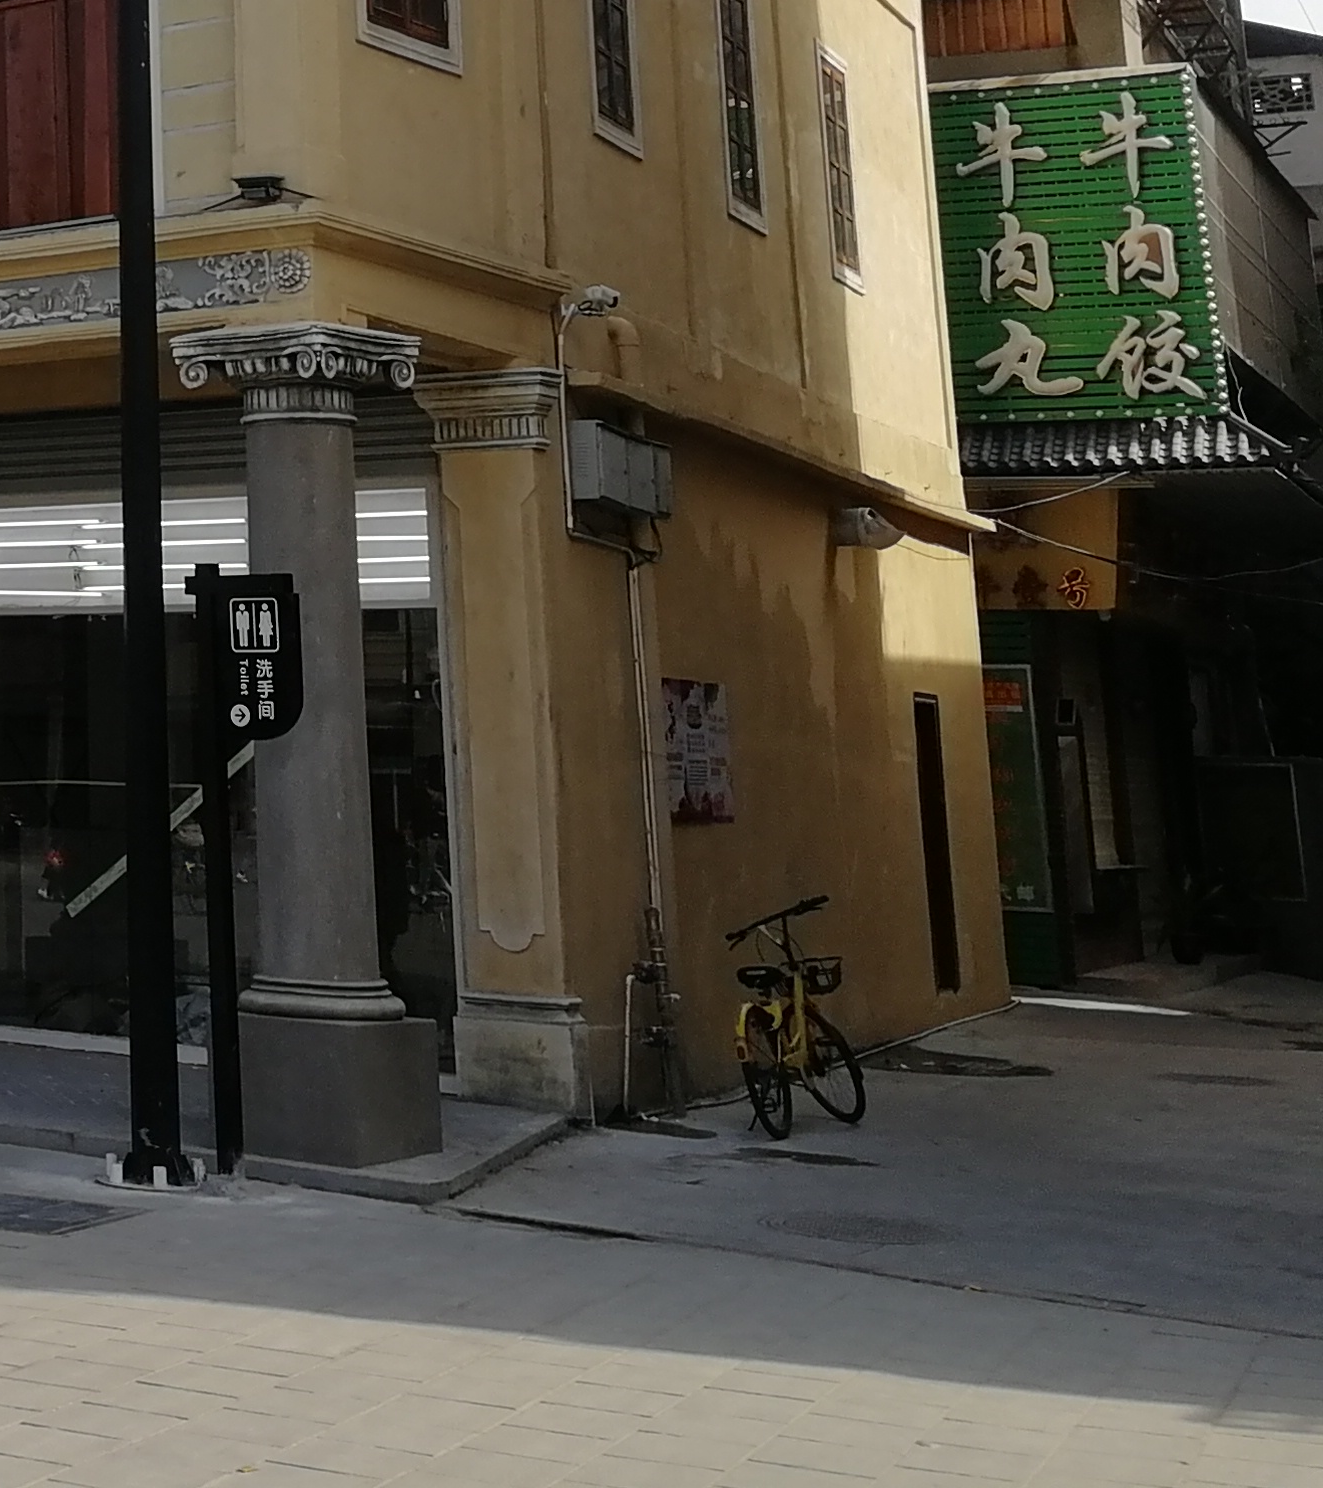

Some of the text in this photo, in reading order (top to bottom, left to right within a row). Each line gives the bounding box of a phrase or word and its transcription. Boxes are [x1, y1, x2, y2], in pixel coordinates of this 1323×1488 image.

[955, 101, 1085, 398] 牛肉丸
[1079, 91, 1209, 401] 牛肉饺
[239, 658, 249, 695] Toilet
[255, 658, 275, 720] 洗手间
